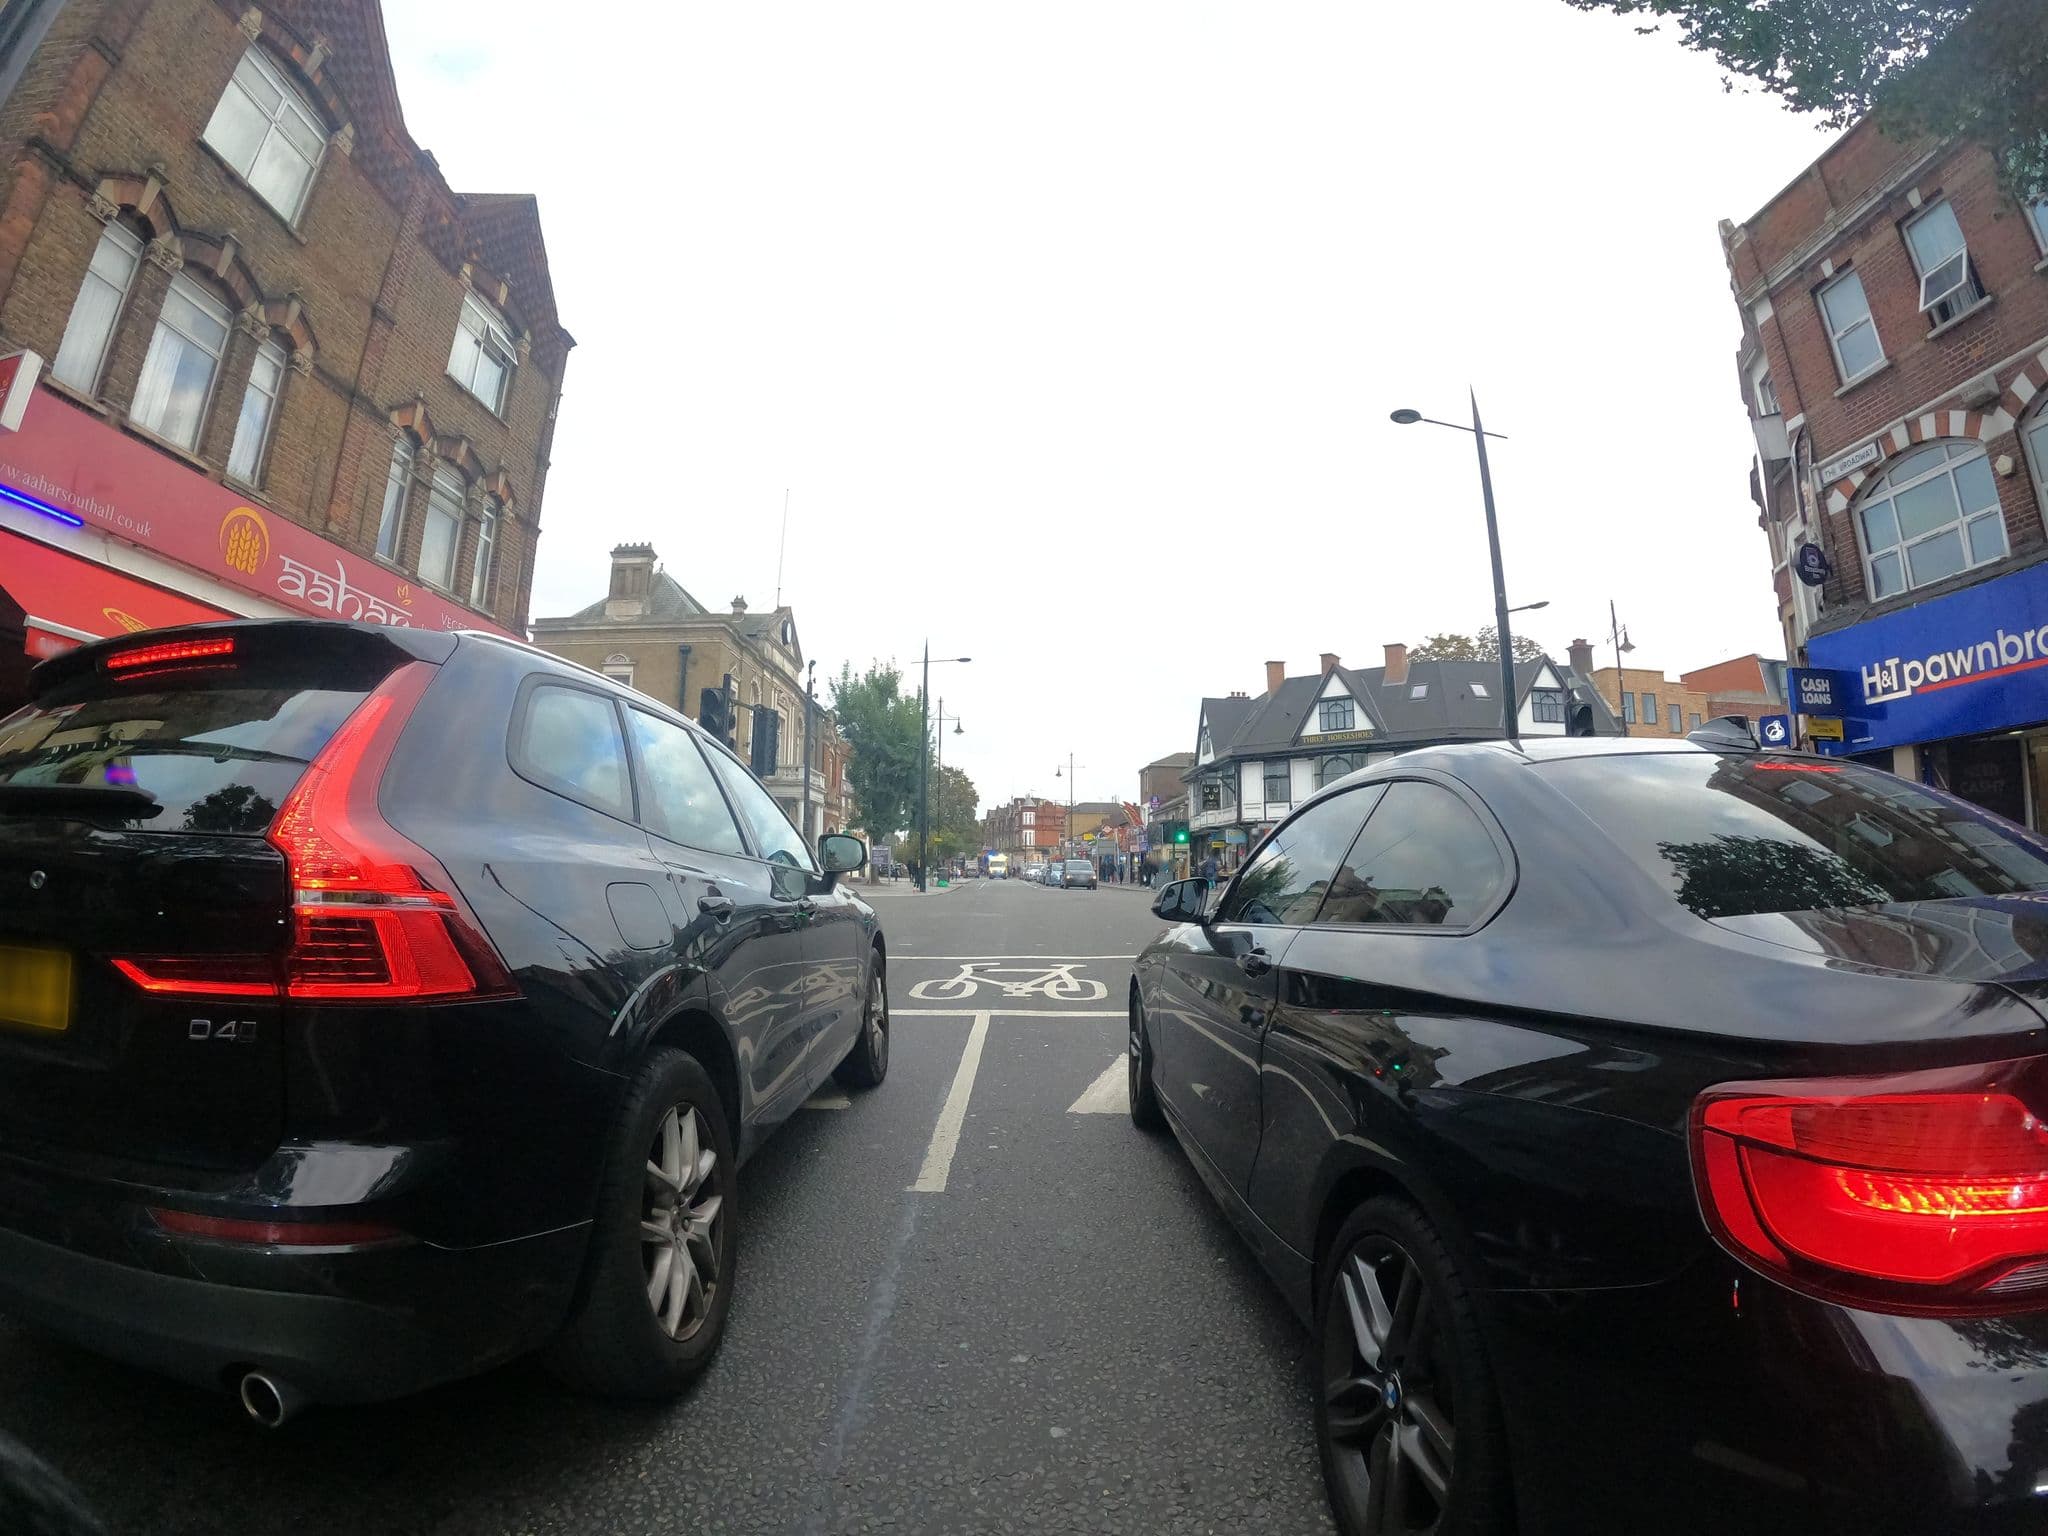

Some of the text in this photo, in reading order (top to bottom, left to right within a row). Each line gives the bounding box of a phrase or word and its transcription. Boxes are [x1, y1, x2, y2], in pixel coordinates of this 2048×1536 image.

[1800, 677, 1830, 692] CASH
[1802, 692, 1832, 705] LOANS
[1303, 731, 1374, 744] THREE HORSESHOES
